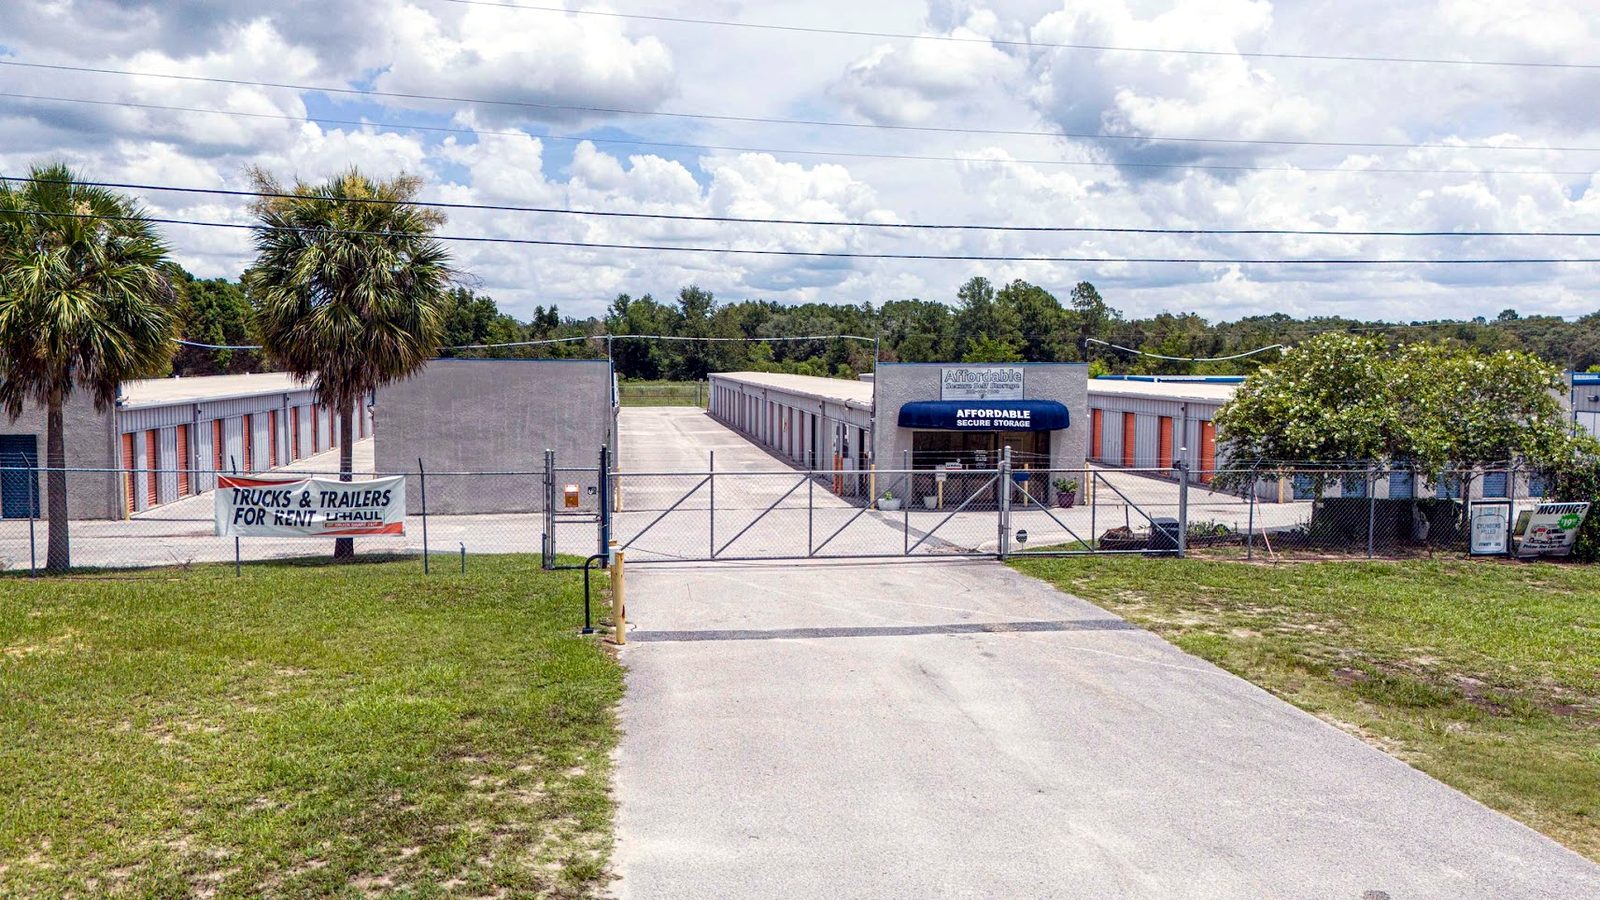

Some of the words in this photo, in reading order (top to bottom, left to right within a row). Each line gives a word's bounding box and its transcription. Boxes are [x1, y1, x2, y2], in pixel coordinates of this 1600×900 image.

[944, 368, 1022, 383] Affordable
[989, 383, 1020, 391] Storage
[956, 409, 1031, 419] AFFORDABLE
[956, 419, 991, 427] SECURE
[993, 419, 1031, 428] STORAGE
[232, 488, 292, 508] TRUCKS
[300, 490, 311, 508] &
[320, 489, 391, 508] TRAILERS
[1536, 504, 1588, 515] MOVING?
[233, 507, 266, 526] FOR
[274, 510, 316, 527] RENT
[326, 510, 383, 521] U-HAUL
